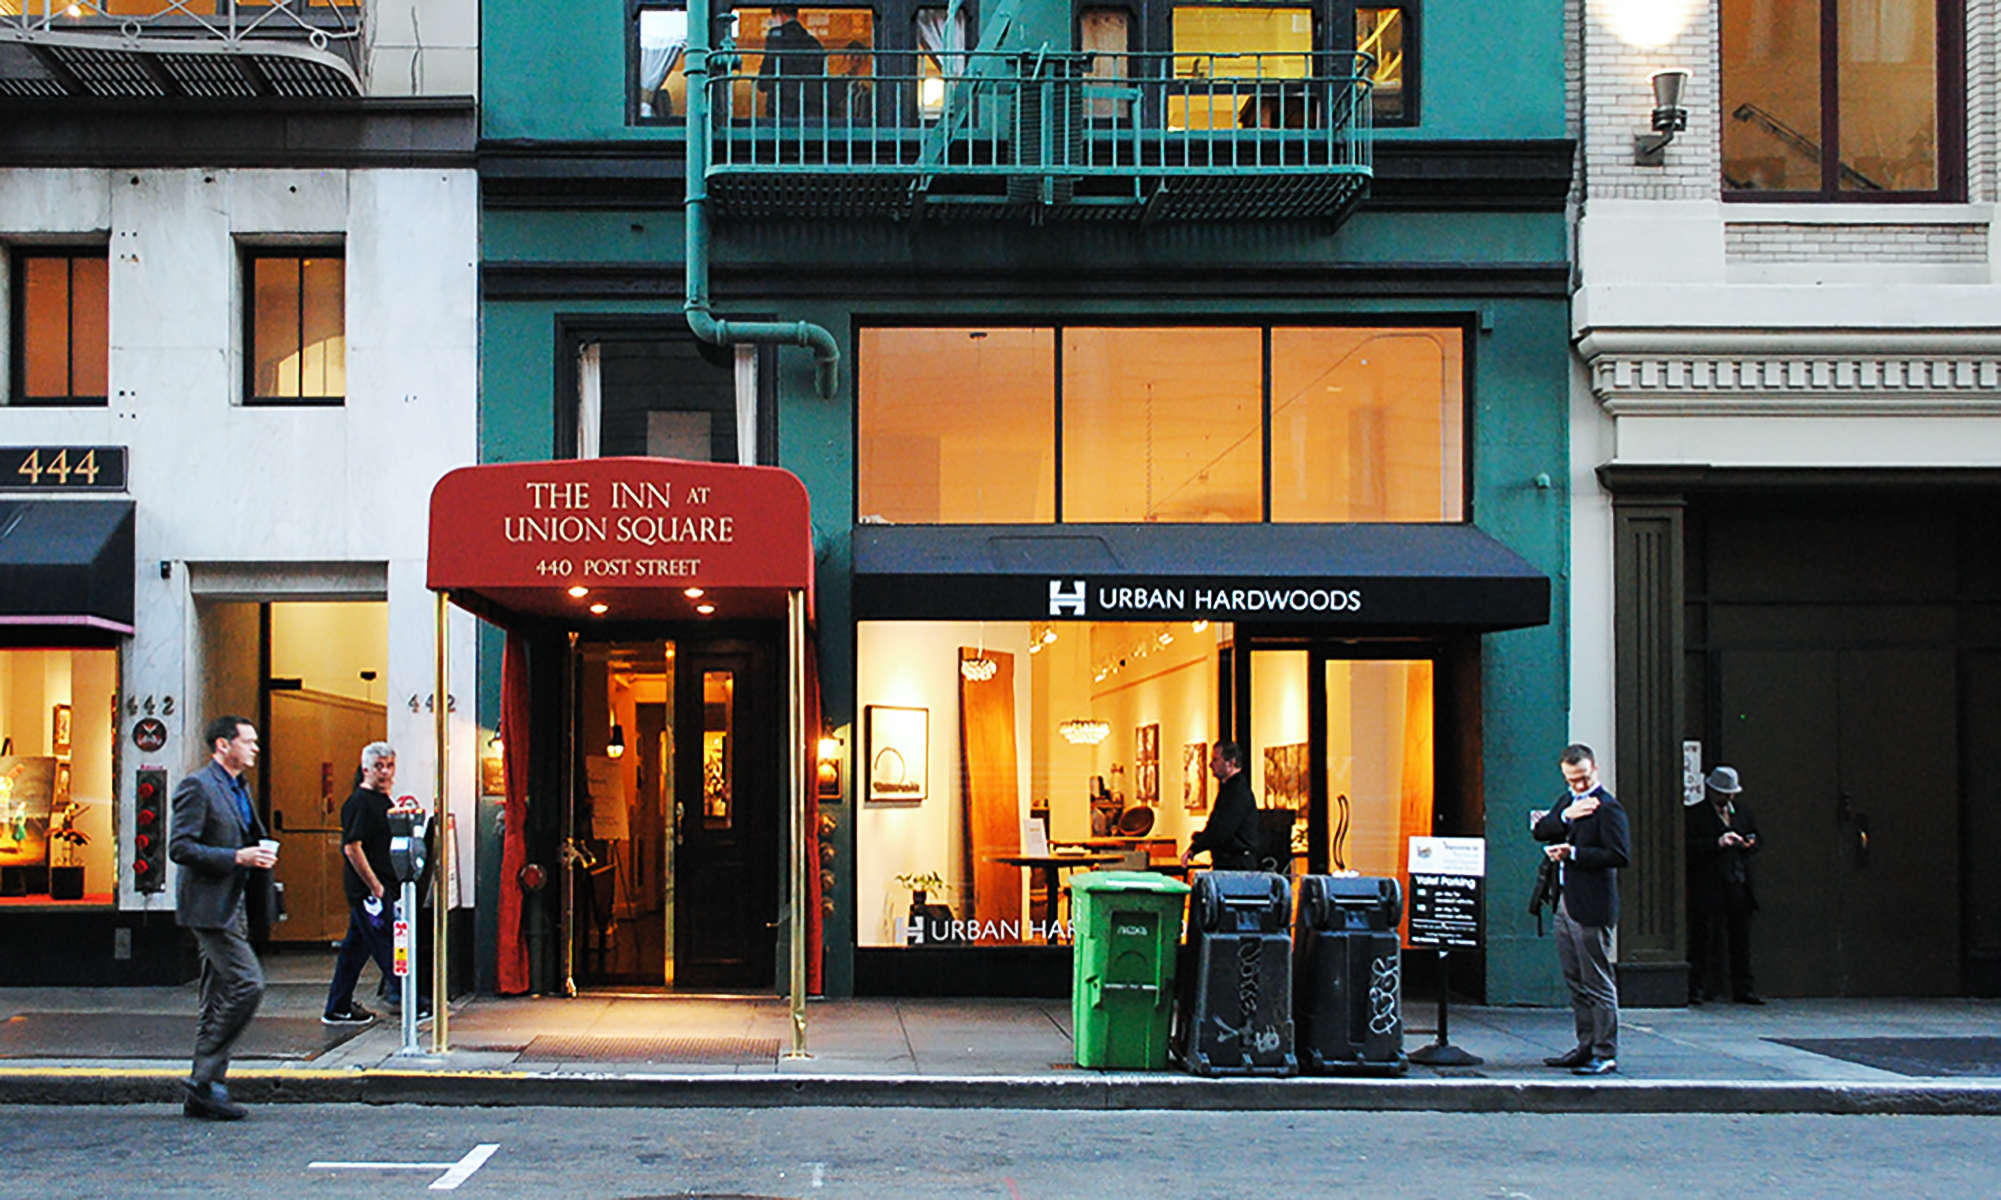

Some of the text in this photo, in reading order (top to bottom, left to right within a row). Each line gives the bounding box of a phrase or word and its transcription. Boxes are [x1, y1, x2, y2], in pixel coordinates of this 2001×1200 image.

[18, 448, 100, 484] 444
[526, 482, 711, 510] THE INN AT
[504, 515, 734, 545] UNION SQUARE
[536, 559, 701, 576] 440 POST STREET
[1099, 587, 1185, 610] URBAN
[1195, 589, 1361, 612] HARDWOODS
[127, 694, 175, 716] 442
[931, 919, 1019, 941] URBAN
